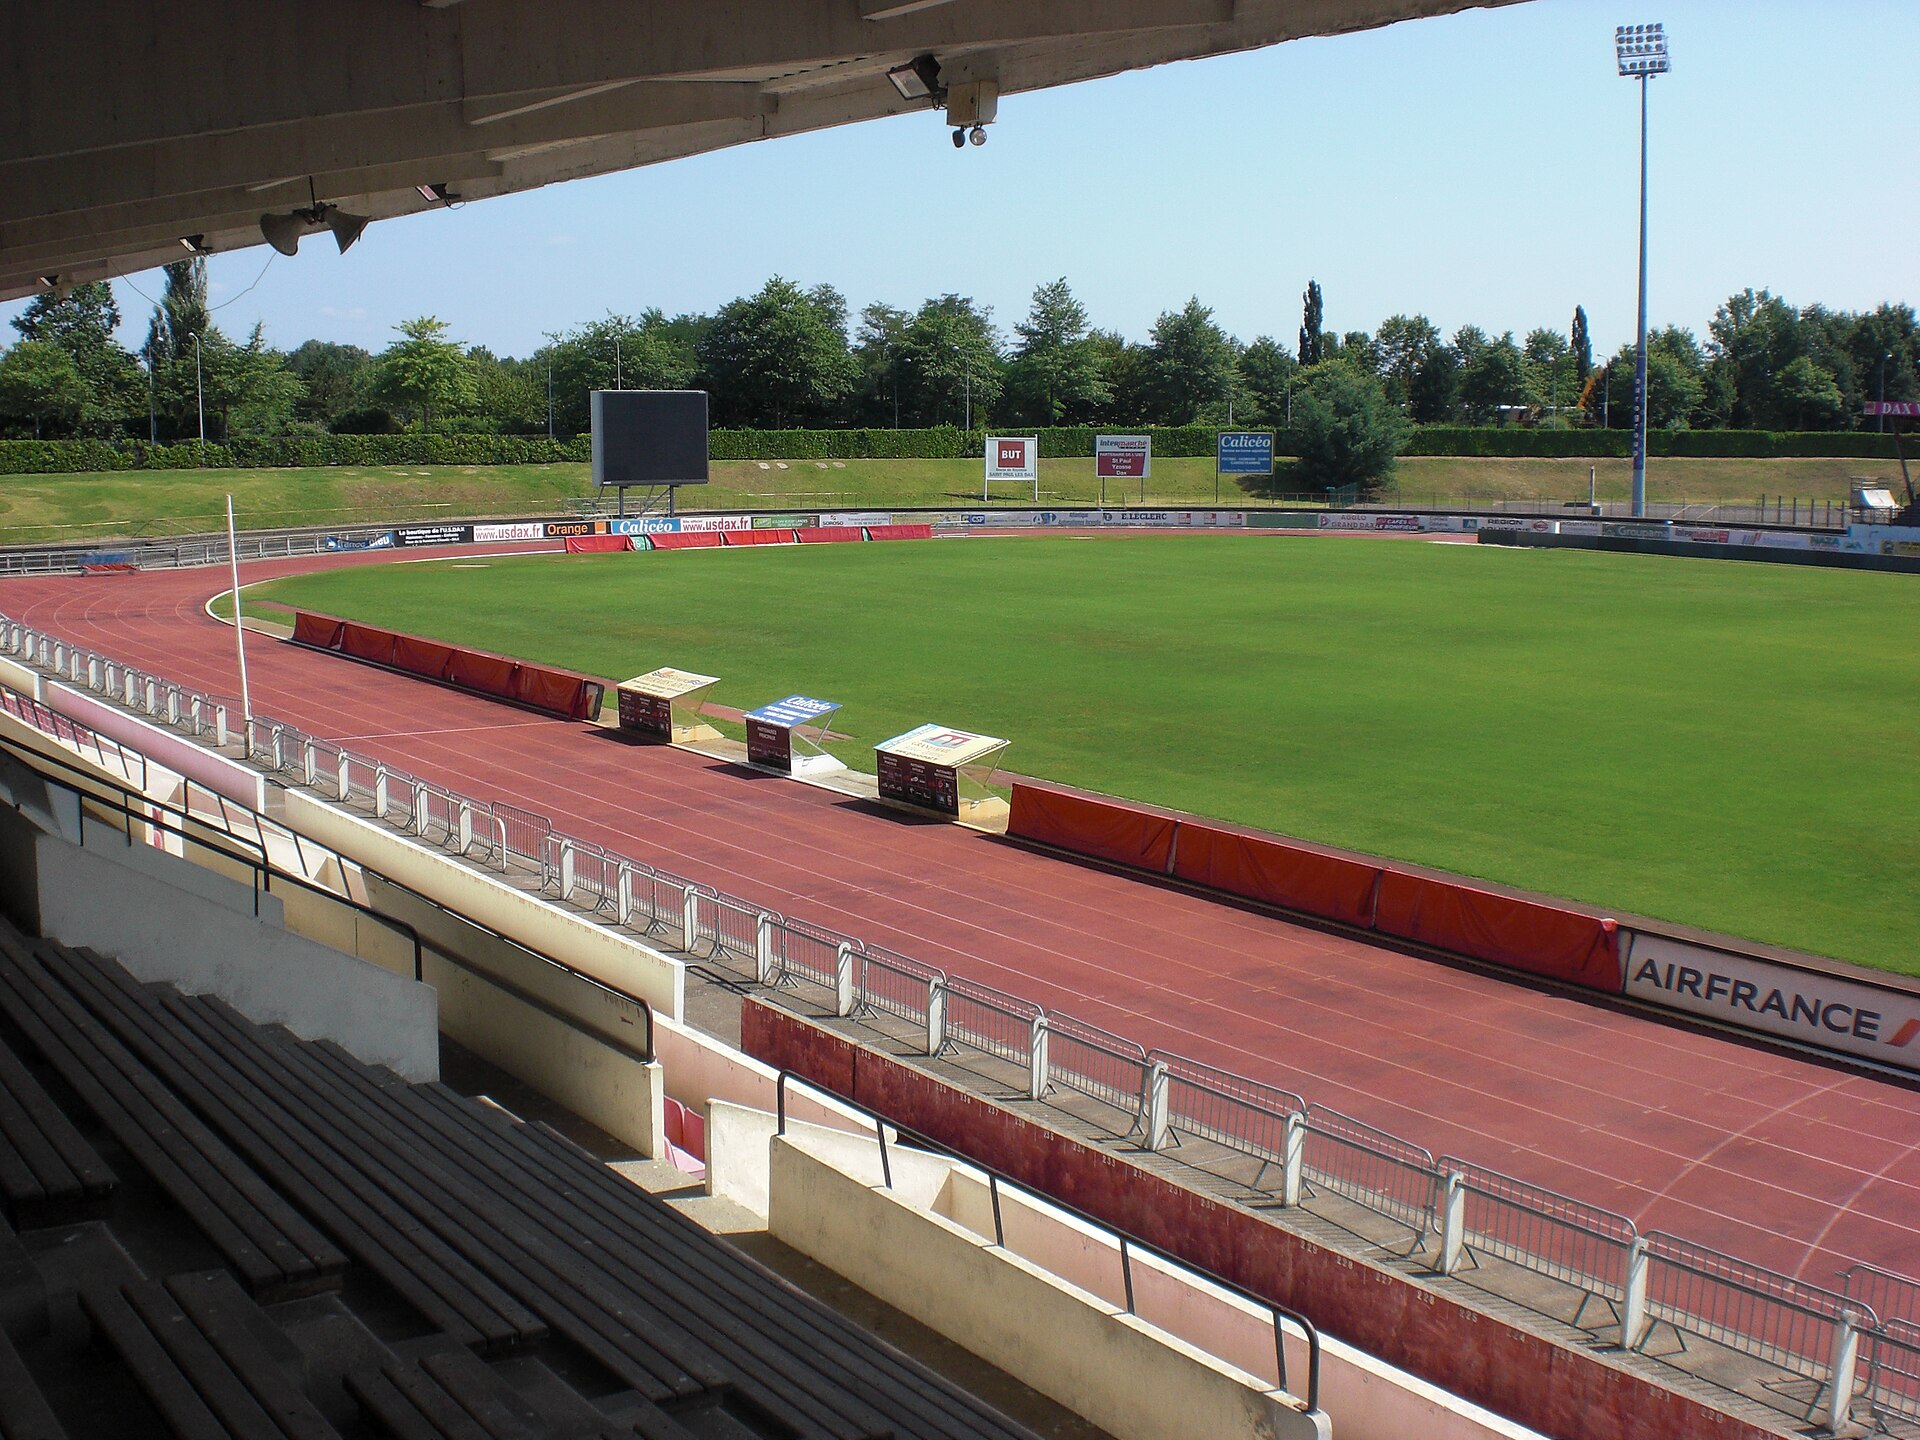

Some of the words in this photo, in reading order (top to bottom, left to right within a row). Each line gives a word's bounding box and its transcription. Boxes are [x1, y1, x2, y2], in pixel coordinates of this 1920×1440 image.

[1882, 402, 1911, 415] DAX
[1221, 435, 1271, 448] Calicéo
[1001, 450, 1022, 459] BUT
[547, 523, 588, 537] Orange
[620, 520, 673, 534] Calicéo
[683, 517, 749, 532] www.usdax.fr
[1618, 525, 1668, 538] Groupama
[475, 524, 541, 540] www.usdax.fr
[1633, 958, 1882, 1042] AIRFRANCE
